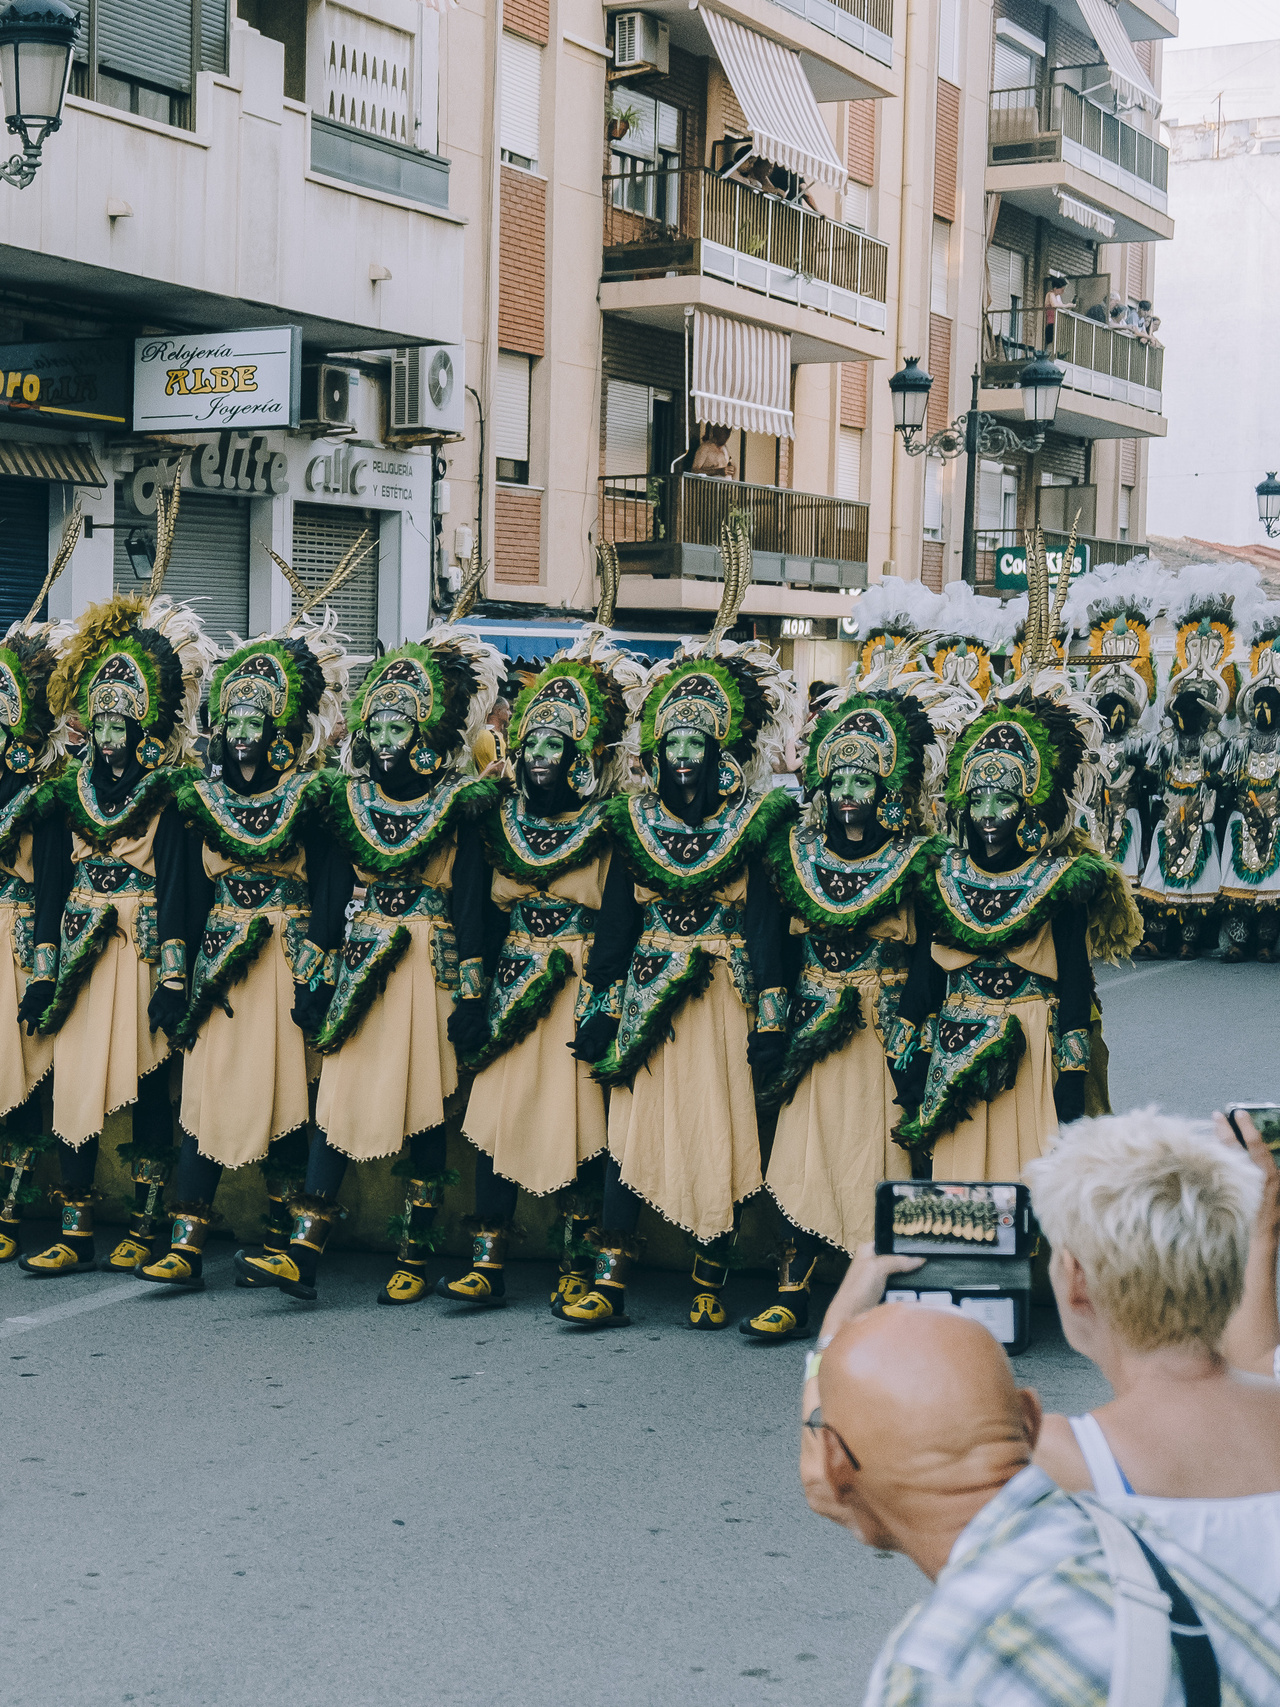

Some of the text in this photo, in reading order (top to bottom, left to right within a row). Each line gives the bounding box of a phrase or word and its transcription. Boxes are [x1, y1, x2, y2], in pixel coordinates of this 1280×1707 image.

[140, 341, 234, 368] Relojería
[164, 365, 259, 396] ALBE
[194, 394, 282, 424] Joyería
[372, 484, 413, 500] Y ESTÉTICA
[1045, 551, 1082, 574] Kis
[782, 618, 811, 635] MODA
